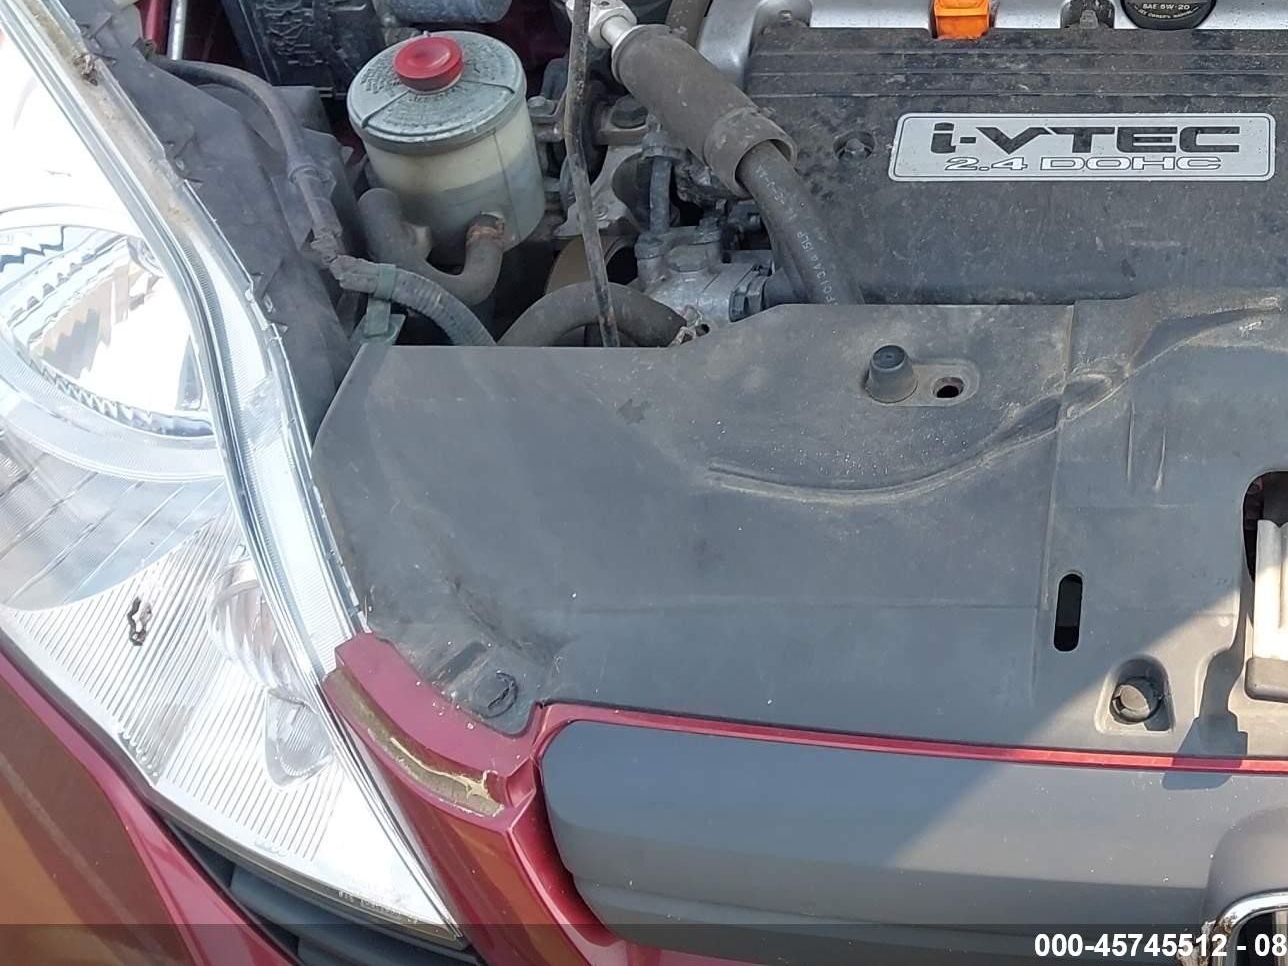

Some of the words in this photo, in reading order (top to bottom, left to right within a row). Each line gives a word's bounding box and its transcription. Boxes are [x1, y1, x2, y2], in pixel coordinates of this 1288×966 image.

[930, 122, 1240, 155] i-VTEC
[944, 156, 1028, 172] 2.4
[1039, 156, 1222, 172] DOHC
